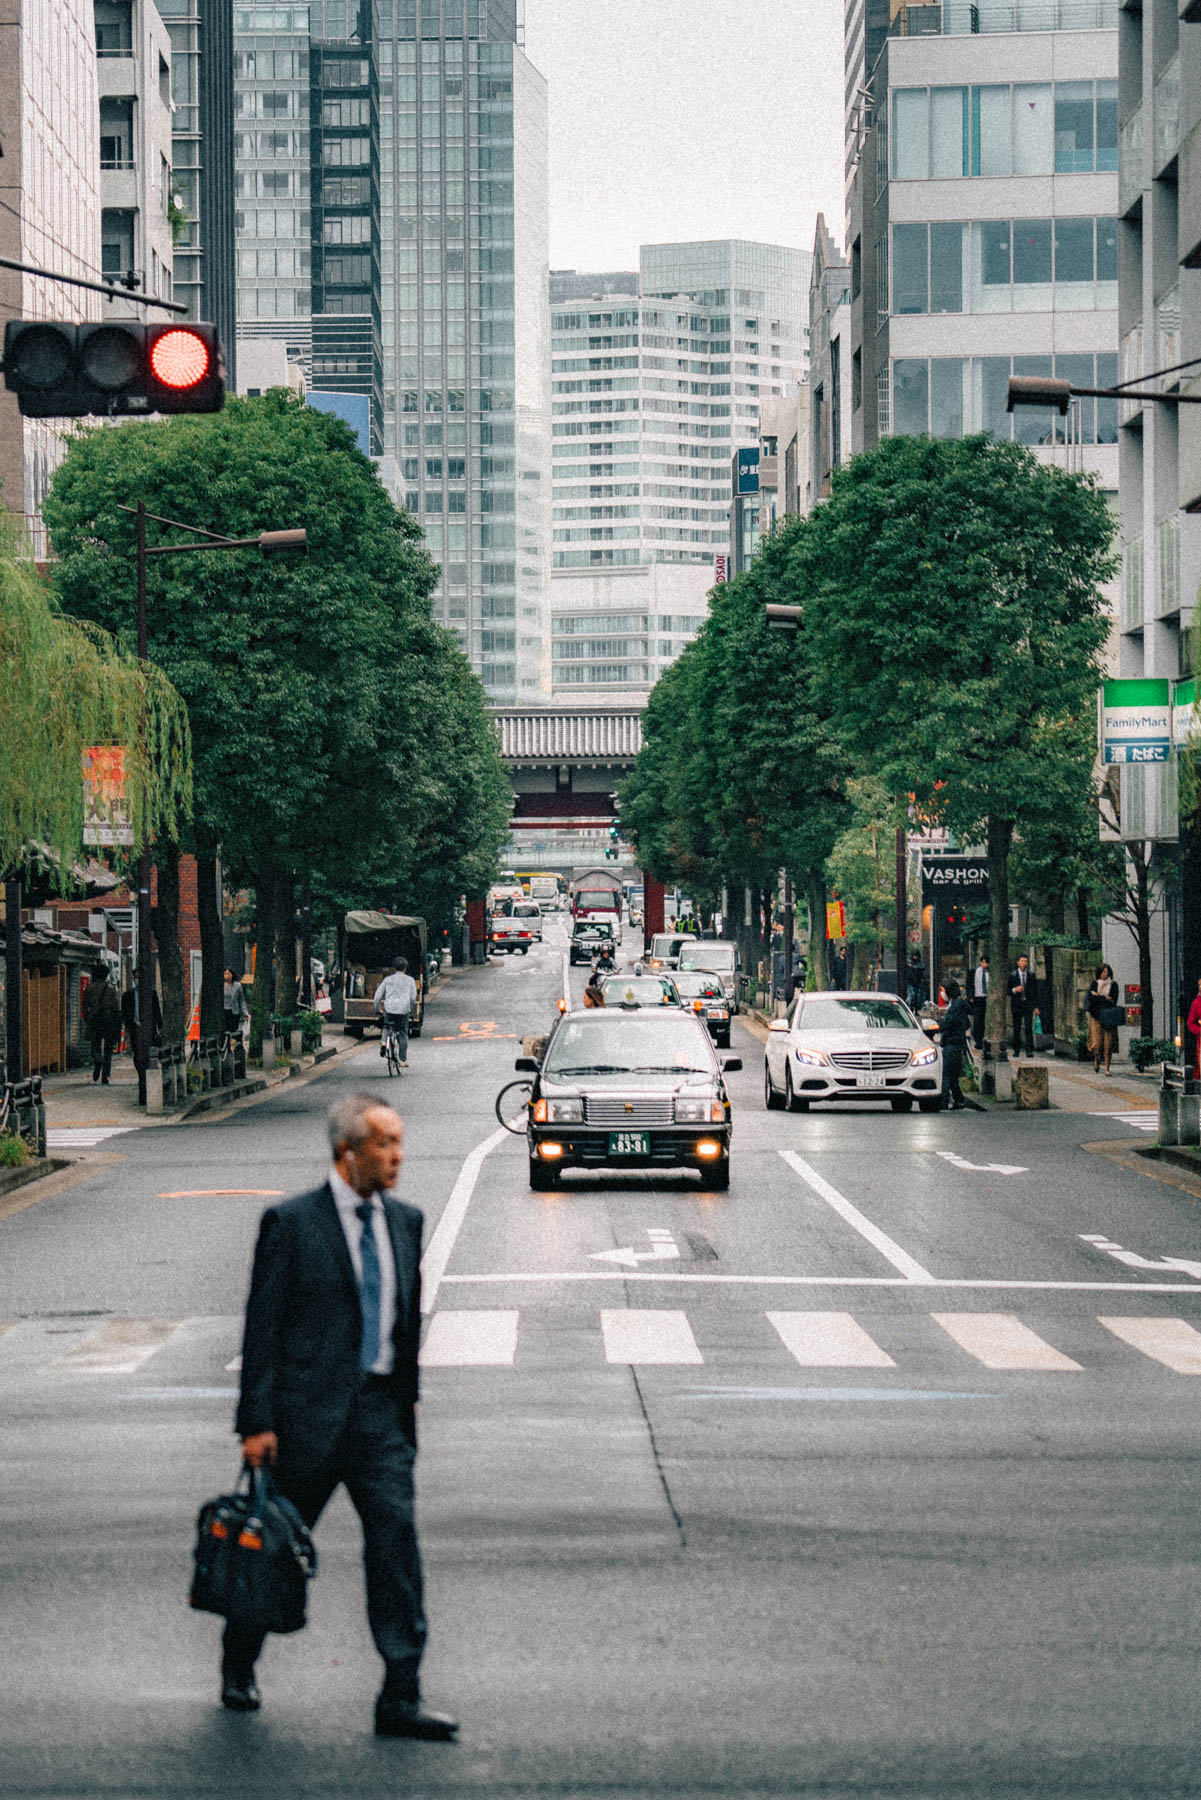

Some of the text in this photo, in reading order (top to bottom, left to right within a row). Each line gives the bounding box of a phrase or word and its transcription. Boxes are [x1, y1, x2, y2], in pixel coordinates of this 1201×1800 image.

[1106, 717, 1167, 728] FamilyMart
[1110, 746, 1165, 762] 酒 たばこ
[923, 867, 989, 879] VASHON
